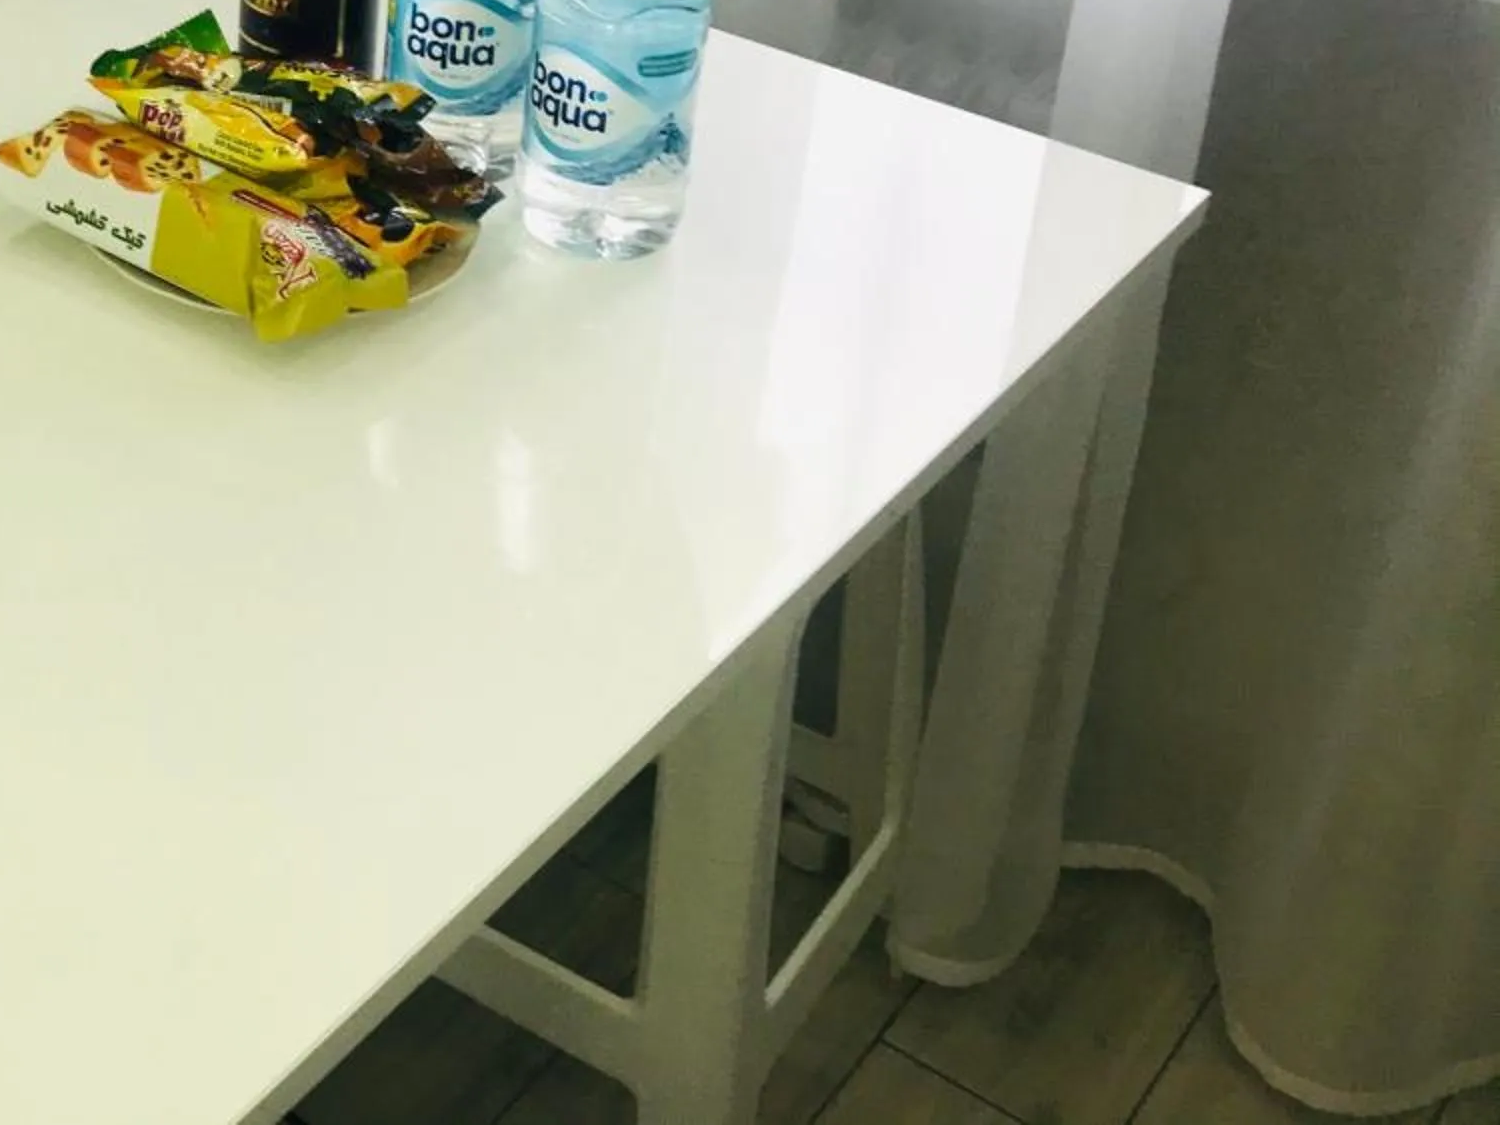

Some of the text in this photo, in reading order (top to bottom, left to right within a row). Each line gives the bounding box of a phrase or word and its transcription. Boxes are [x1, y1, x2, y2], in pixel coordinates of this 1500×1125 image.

[412, 2, 476, 42] bon
[407, 33, 495, 69] aqua
[534, 51, 587, 103] bon
[532, 83, 607, 133] aqua
